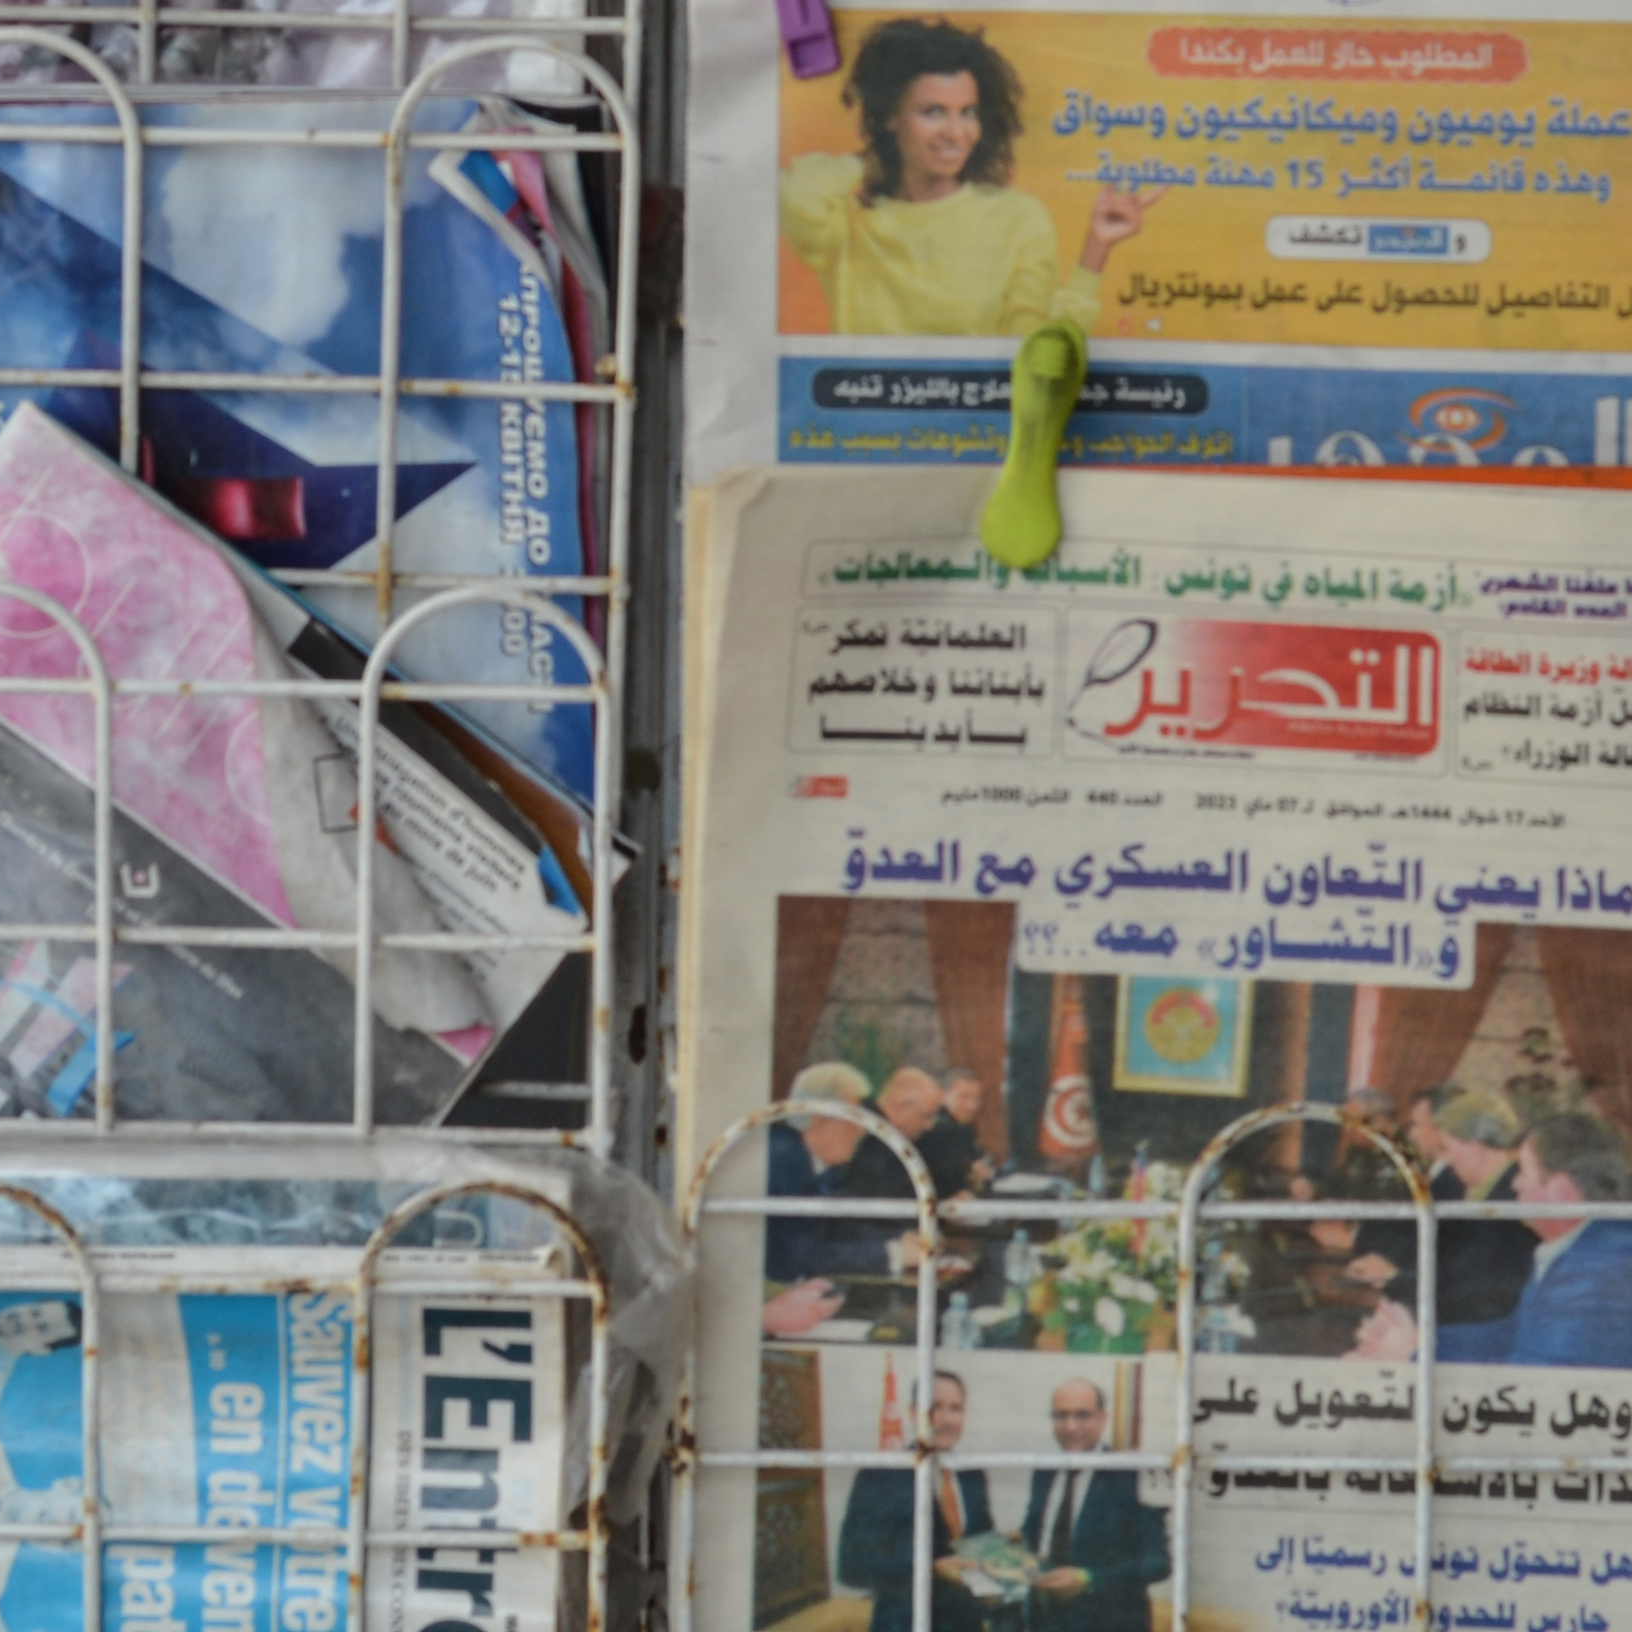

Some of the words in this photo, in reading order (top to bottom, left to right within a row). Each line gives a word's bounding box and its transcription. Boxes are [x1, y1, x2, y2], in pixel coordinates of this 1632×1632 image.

[1050, 88, 1167, 140] وسواق
[1173, 92, 1400, 148] وميكانيكيون
[1405, 104, 1538, 150] يوميون
[1203, 154, 1275, 192] مهنة
[1285, 160, 1324, 191] 15
[1248, 277, 1307, 313] عمل
[1316, 280, 1362, 314] على
[1369, 279, 1480, 314] للحصول
[1483, 281, 1611, 321] التفاصيل
[525, 506, 552, 565] ДО
[1102, 646, 1436, 746] التحرير
[971, 844, 1038, 896] مع
[1052, 842, 1250, 911] العسكري
[286, 1290, 356, 1475] Sauvez
[209, 1380, 270, 1456] en
[1440, 1382, 1538, 1446] يكون
